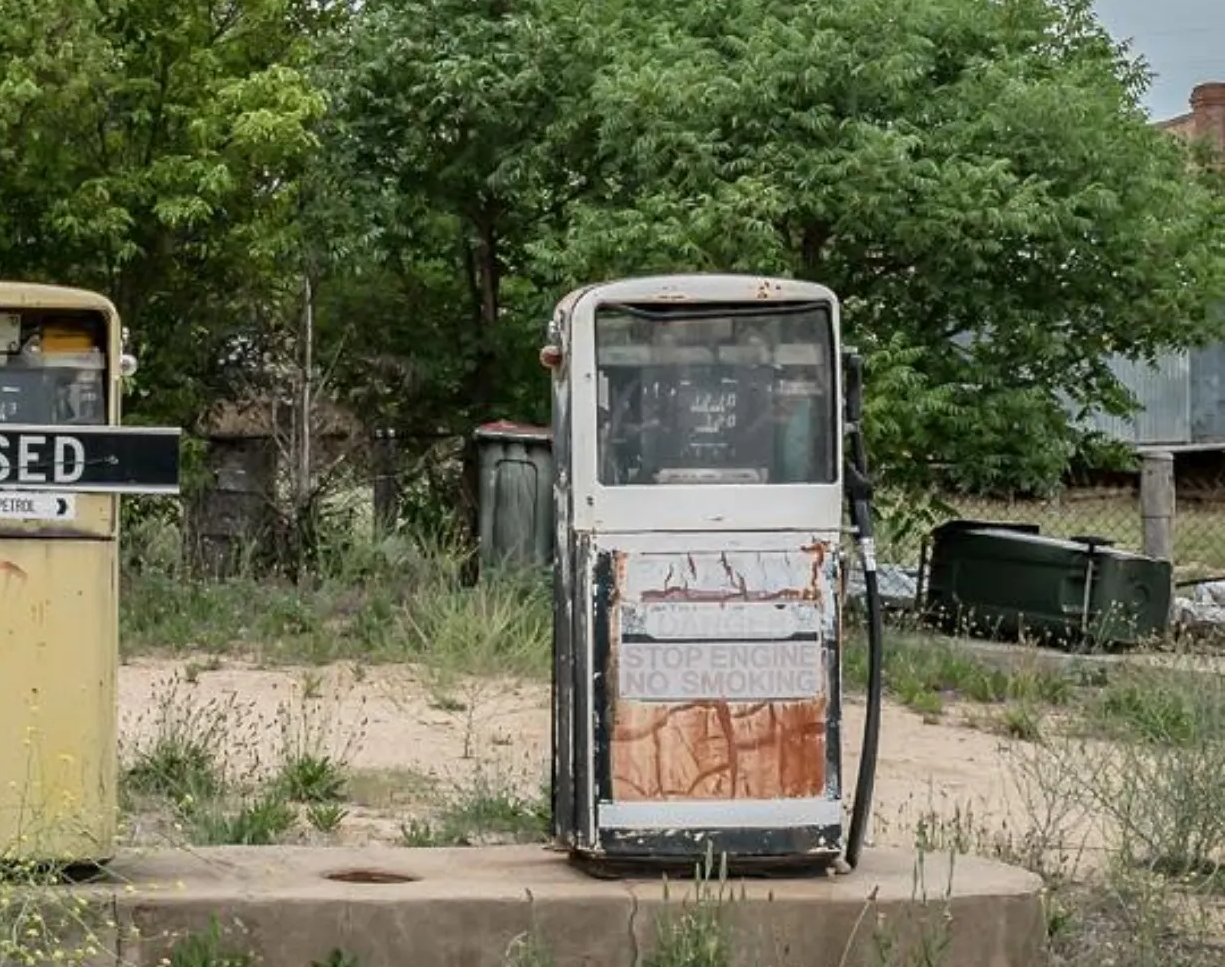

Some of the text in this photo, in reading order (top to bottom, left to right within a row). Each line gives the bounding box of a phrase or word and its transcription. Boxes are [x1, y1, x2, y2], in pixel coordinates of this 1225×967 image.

[625, 644, 816, 669] STOP ENGINE
[625, 670, 816, 695] NO SMOKING
